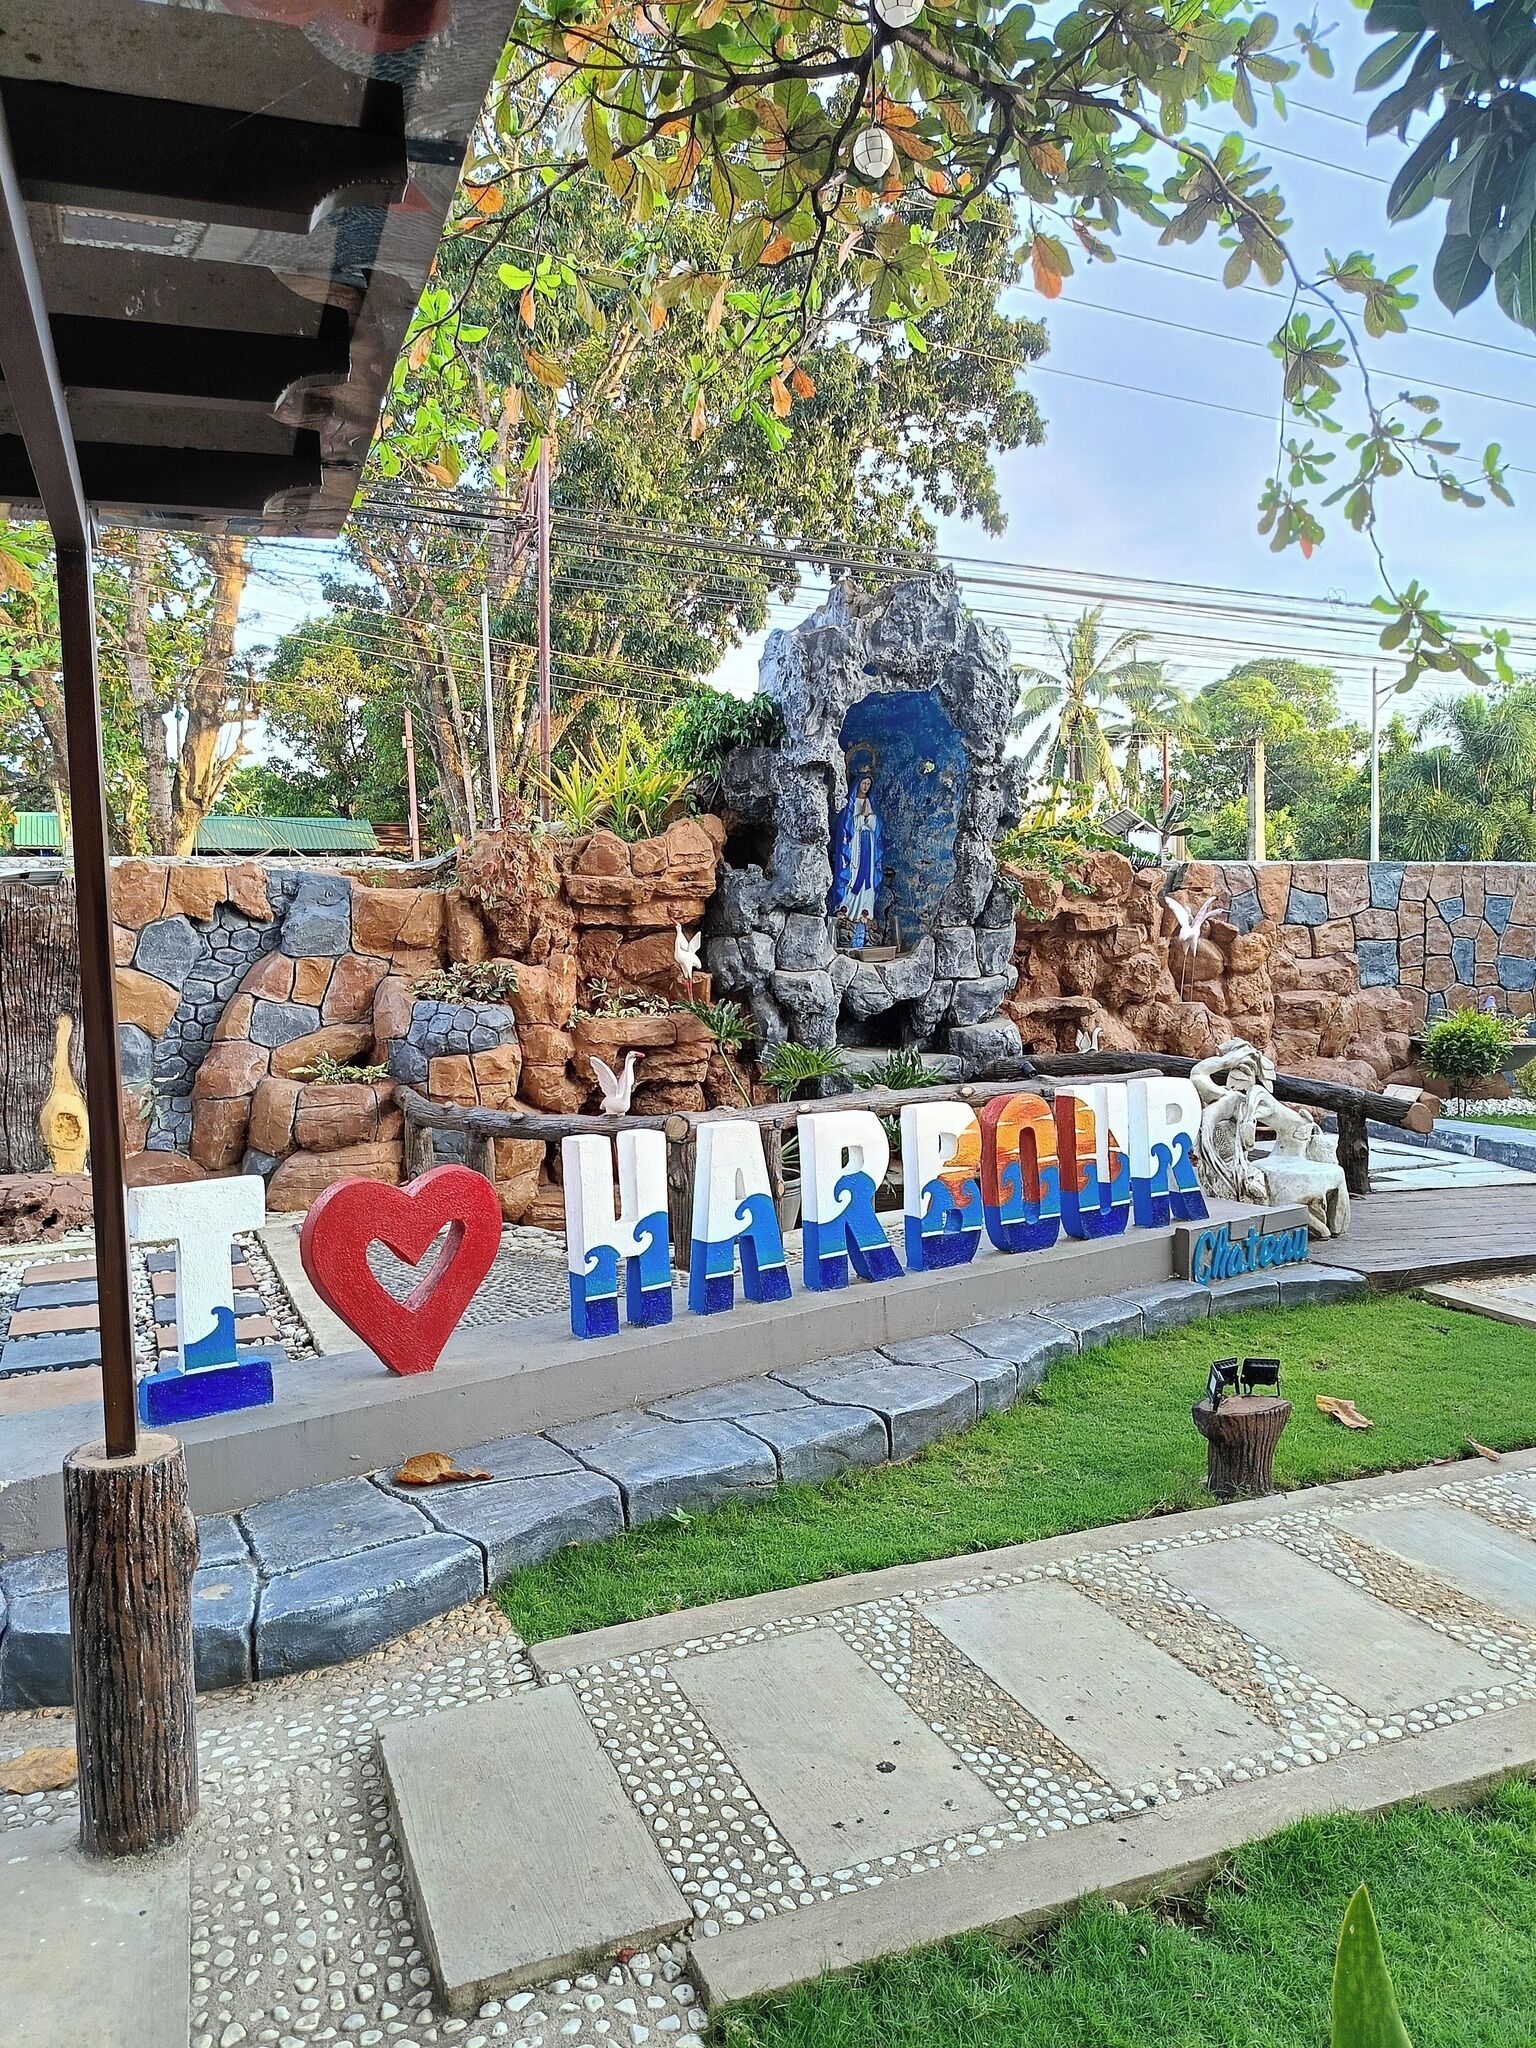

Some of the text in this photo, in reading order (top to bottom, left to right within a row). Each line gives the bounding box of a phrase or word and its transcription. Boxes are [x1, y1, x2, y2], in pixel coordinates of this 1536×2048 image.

[128, 1077, 1211, 1426] I HARBOUR
[1192, 1224, 1309, 1286] Chateau
